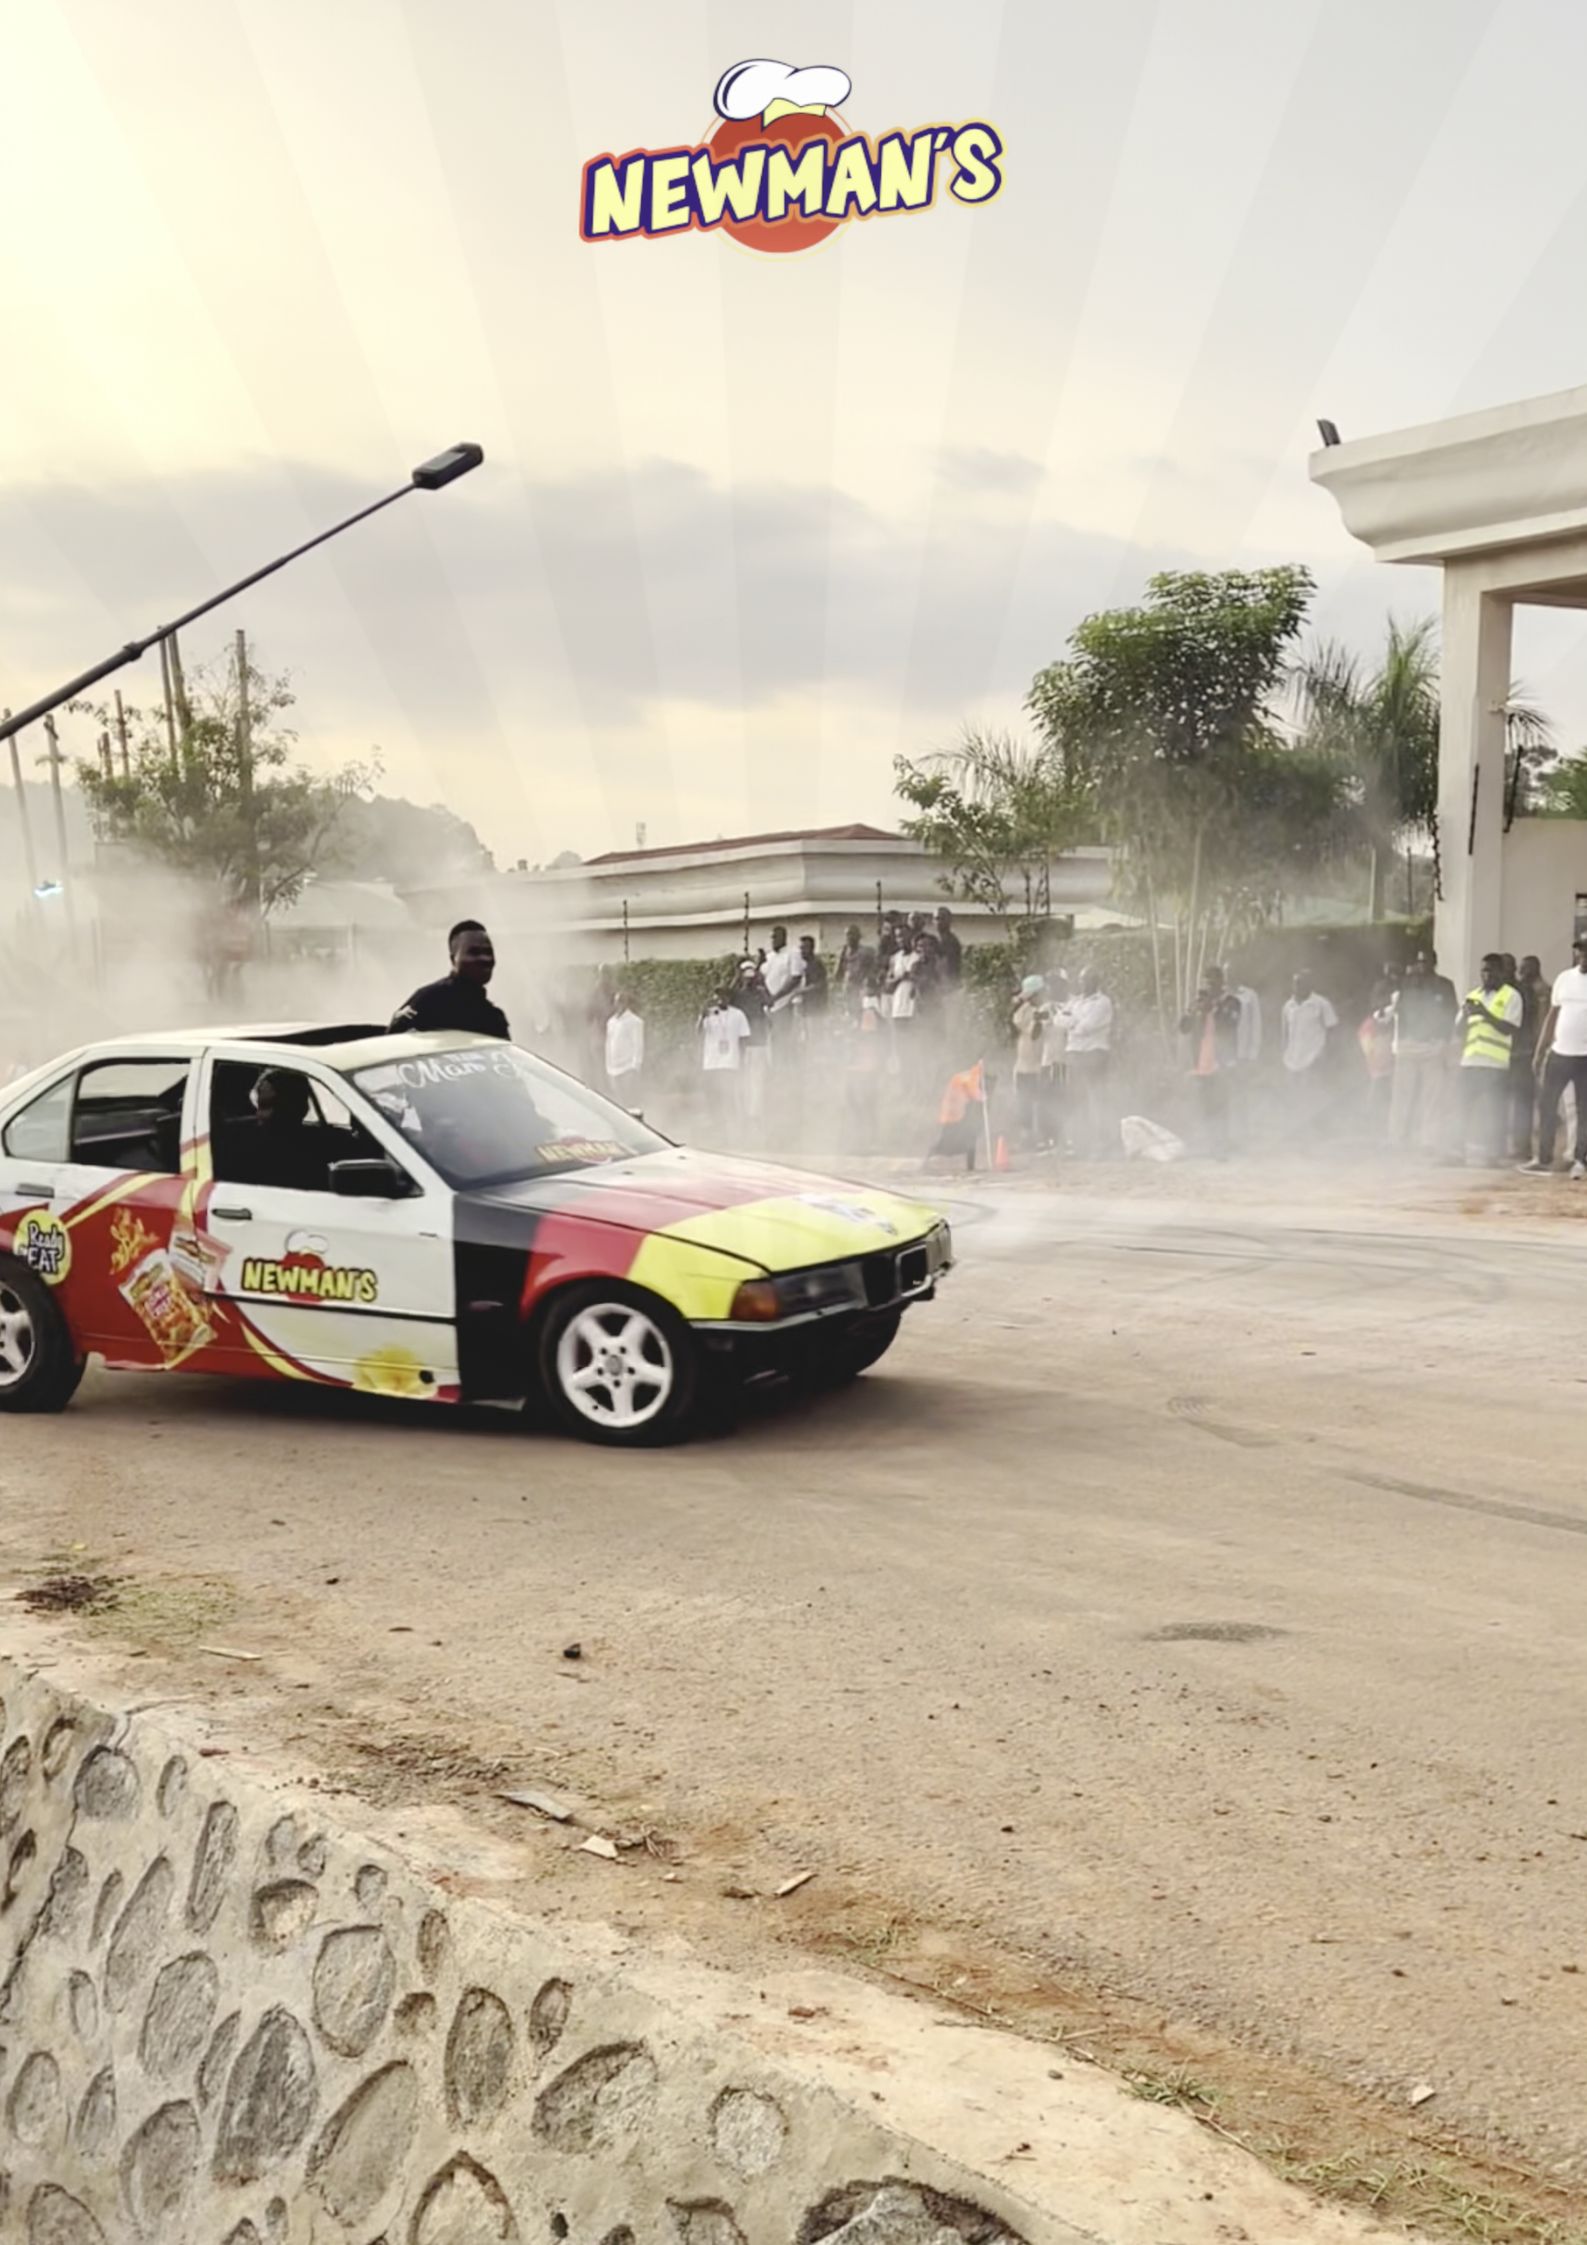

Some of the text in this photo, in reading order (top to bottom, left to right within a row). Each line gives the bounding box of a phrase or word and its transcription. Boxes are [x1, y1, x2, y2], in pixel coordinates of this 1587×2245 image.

[28, 1247, 58, 1273] EAT
[29, 1222, 64, 1260] Ready
[242, 1259, 377, 1301] NEWMAN'S
